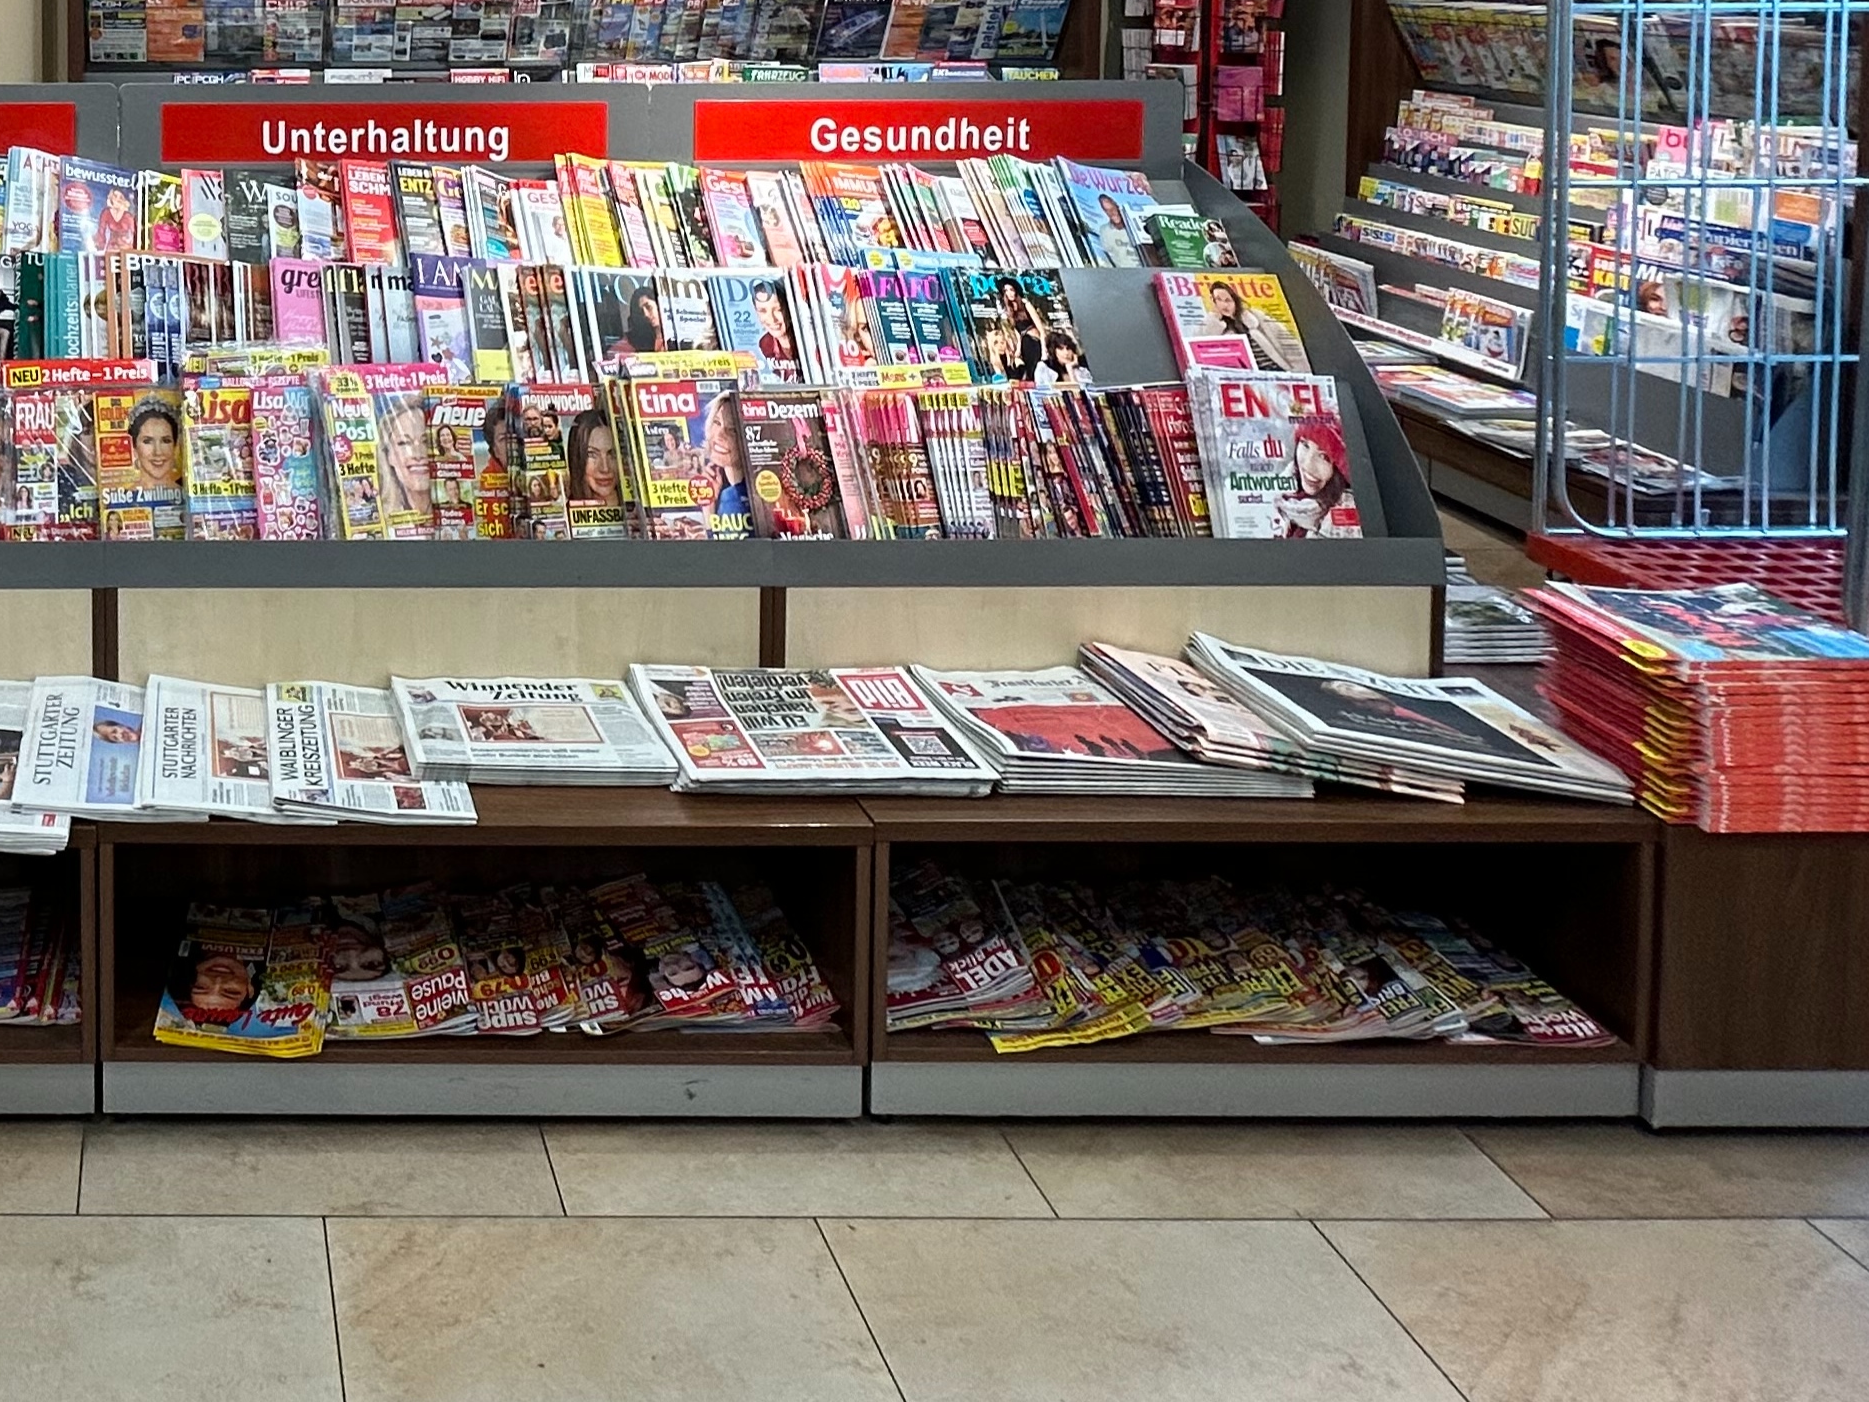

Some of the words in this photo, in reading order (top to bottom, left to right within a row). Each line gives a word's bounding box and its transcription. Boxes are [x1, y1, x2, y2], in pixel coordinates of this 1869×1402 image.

[980, 6, 1001, 49] palstek
[454, 74, 486, 84] HOBBY
[1008, 70, 1059, 81] TAUCHEN
[263, 120, 509, 161] Unterhaltung
[811, 118, 1030, 151] Gesundheit
[65, 163, 131, 187] bewusster
[348, 169, 383, 182] LEBEN
[1173, 276, 1274, 298] Briitte
[733, 310, 751, 323] 22
[839, 341, 859, 356] 10
[12, 370, 40, 384] NEU
[42, 370, 51, 382] 2
[54, 367, 91, 381] Hefte
[103, 368, 111, 379] 1
[114, 366, 147, 378] Preis
[366, 376, 374, 388] 3
[416, 372, 447, 386] Preis
[196, 391, 251, 423] Lisa
[253, 393, 282, 409] Lisa
[332, 399, 371, 418] Neue
[639, 387, 695, 414] tina
[16, 404, 54, 429] FRAU
[432, 406, 486, 427] neue
[743, 402, 767, 417] tina
[768, 401, 818, 419] Dezem
[335, 422, 374, 441] Post
[746, 426, 761, 440] 87
[1228, 441, 1260, 460] Falls
[1264, 434, 1284, 458] du
[341, 464, 347, 476] 3
[349, 464, 375, 475] Hefte
[660, 483, 686, 493] Hefte
[691, 479, 707, 487] nur
[1231, 471, 1297, 491] Antworten
[102, 486, 134, 504] Süße
[663, 495, 687, 505] Preis
[476, 500, 488, 515] Er
[477, 519, 504, 537] sich
[1258, 651, 1315, 671] DIE
[445, 680, 578, 695] Winnender
[718, 673, 809, 688] verbieten!
[491, 688, 580, 705] Zeitung
[736, 702, 817, 714] Rauchen
[787, 715, 807, 726] EU
[32, 693, 64, 786] STUTTGARTER
[57, 707, 81, 769] ZEITUNG
[162, 707, 180, 779] STUTTGARTER
[181, 707, 197, 779] NACHRICHTEN
[281, 707, 295, 782] WAIBLINGER
[303, 703, 319, 789] KREISZEITUNG
[411, 971, 465, 1000] Pause
[415, 990, 469, 1019] Meine
